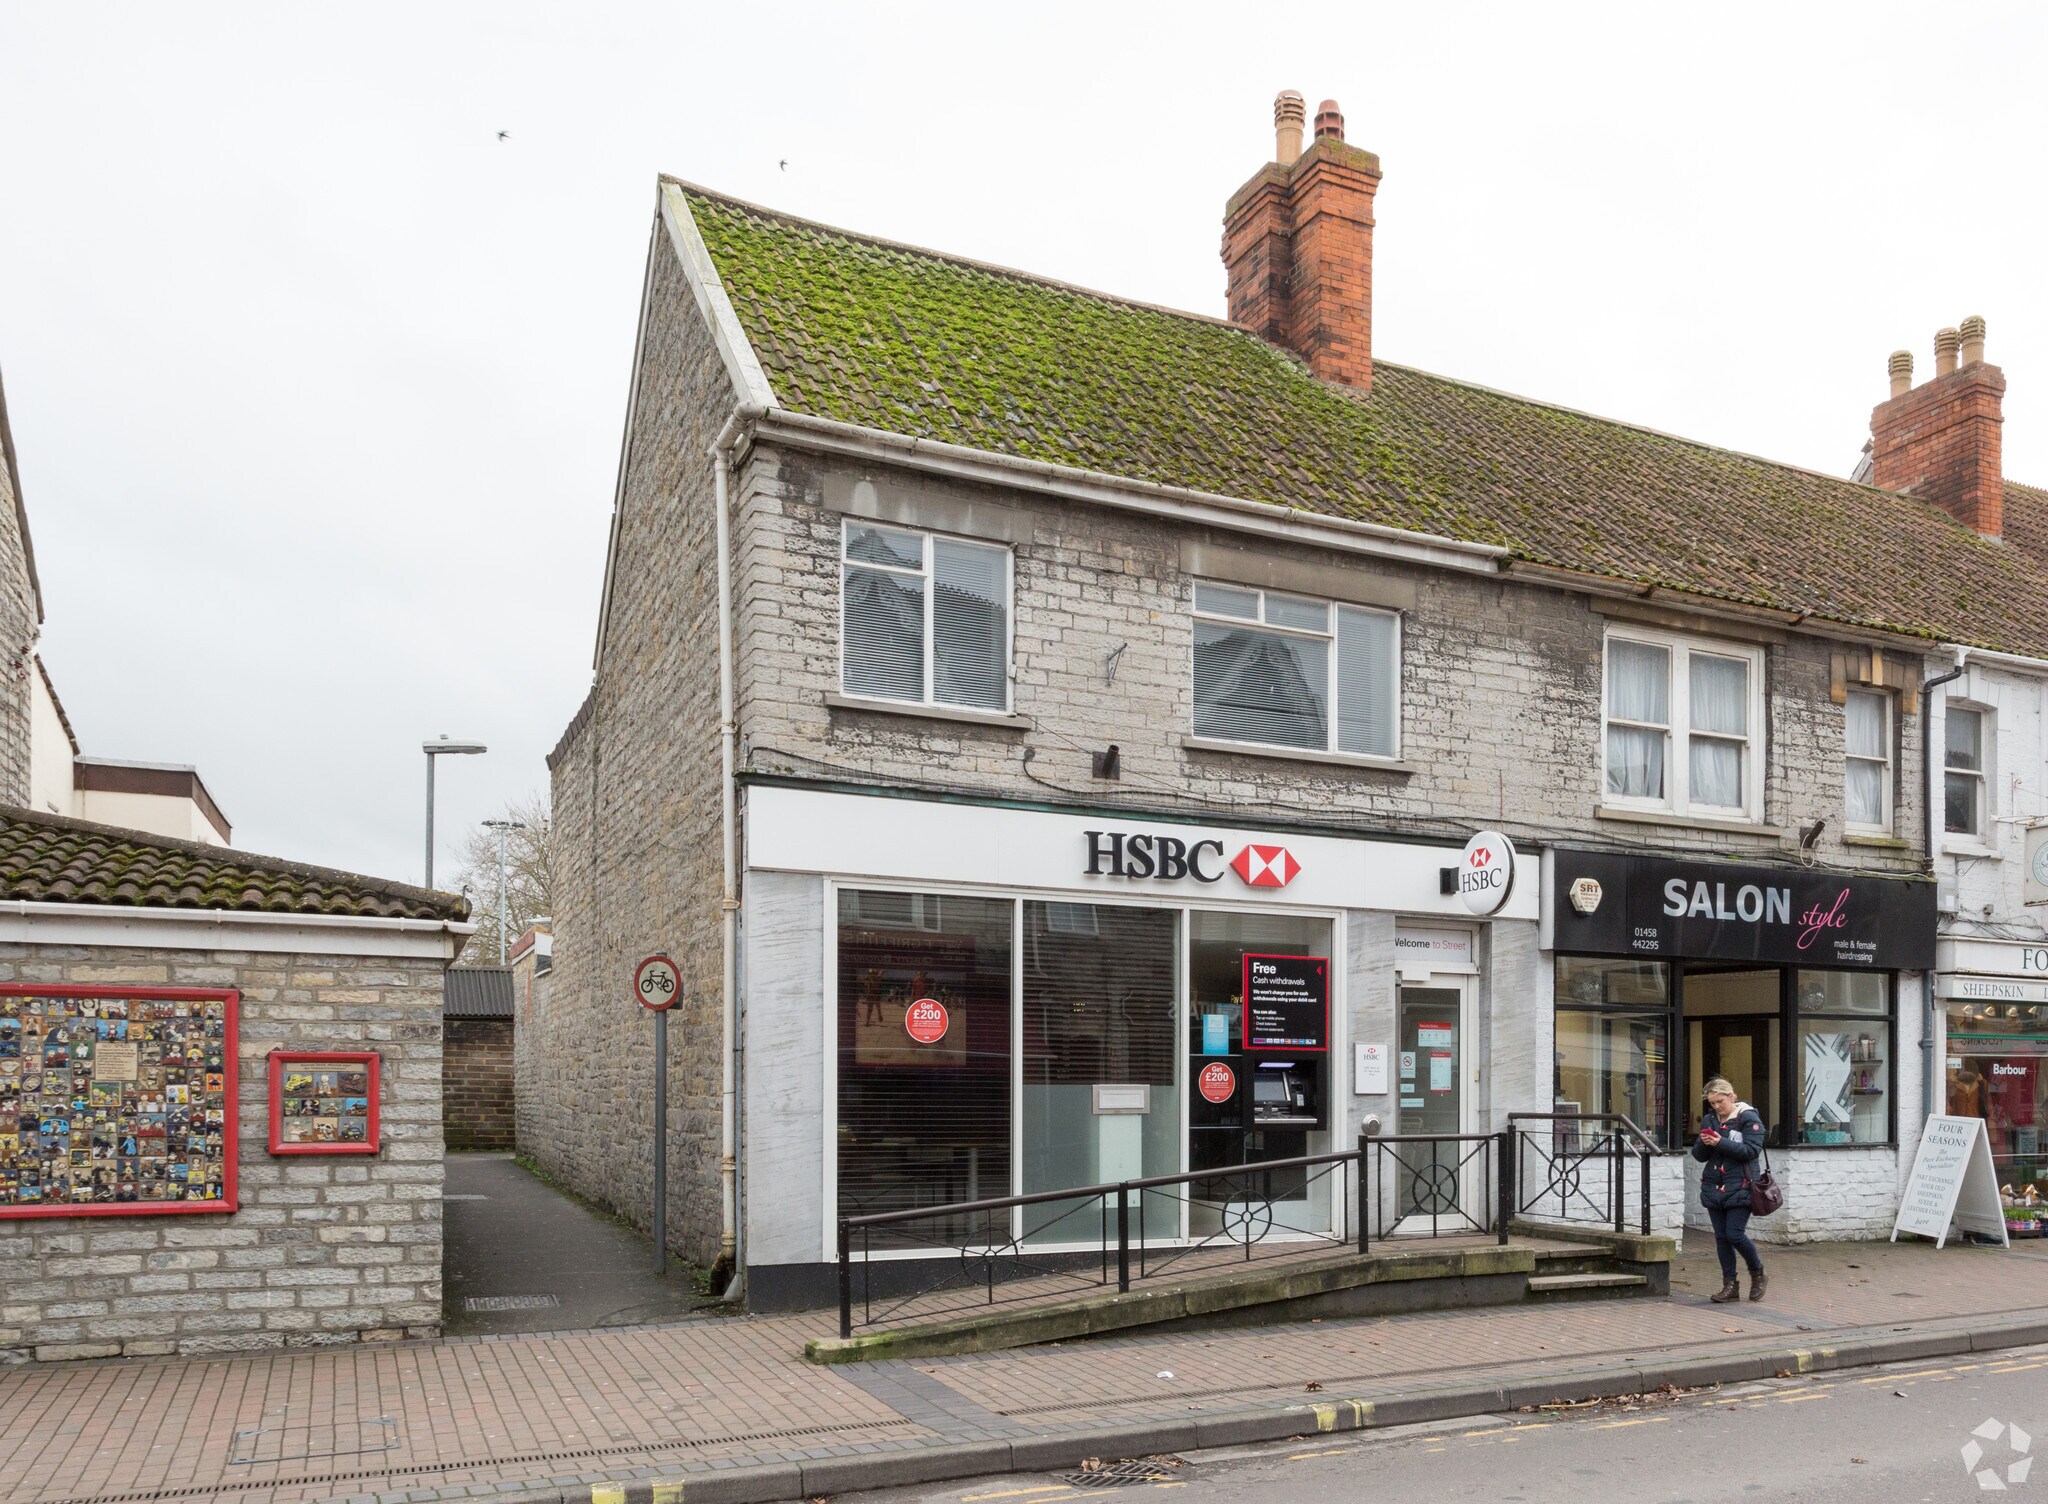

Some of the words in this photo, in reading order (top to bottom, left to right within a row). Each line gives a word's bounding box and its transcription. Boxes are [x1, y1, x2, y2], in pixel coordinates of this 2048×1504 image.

[1083, 831, 1224, 883] HSBC
[1462, 868, 1502, 893] HSBC
[1580, 884, 1599, 892] SRT
[1663, 878, 1791, 925] SALON
[1797, 888, 1850, 949] style
[1634, 927, 1657, 937] 01458
[1432, 941, 1441, 949] to
[1442, 940, 1466, 950] Street
[1632, 939, 1659, 950] 442295
[1834, 940, 1849, 949] male
[1850, 941, 1855, 949] &
[1856, 940, 1877, 950] female
[1837, 951, 1873, 963] hairdressing
[1253, 962, 1277, 974] Free
[1252, 976, 1269, 984] Cash
[1269, 977, 1305, 986] withdrawals
[1963, 983, 2024, 998] SHEEPSKIN
[914, 1009, 941, 1020] £200
[1363, 1053, 1381, 1061] HSBC
[1993, 1063, 2028, 1076] Barbour
[1205, 1072, 1229, 1082] £200
[1938, 1123, 1964, 1135] FOUR
[1927, 1135, 1968, 1148] SEASONS
